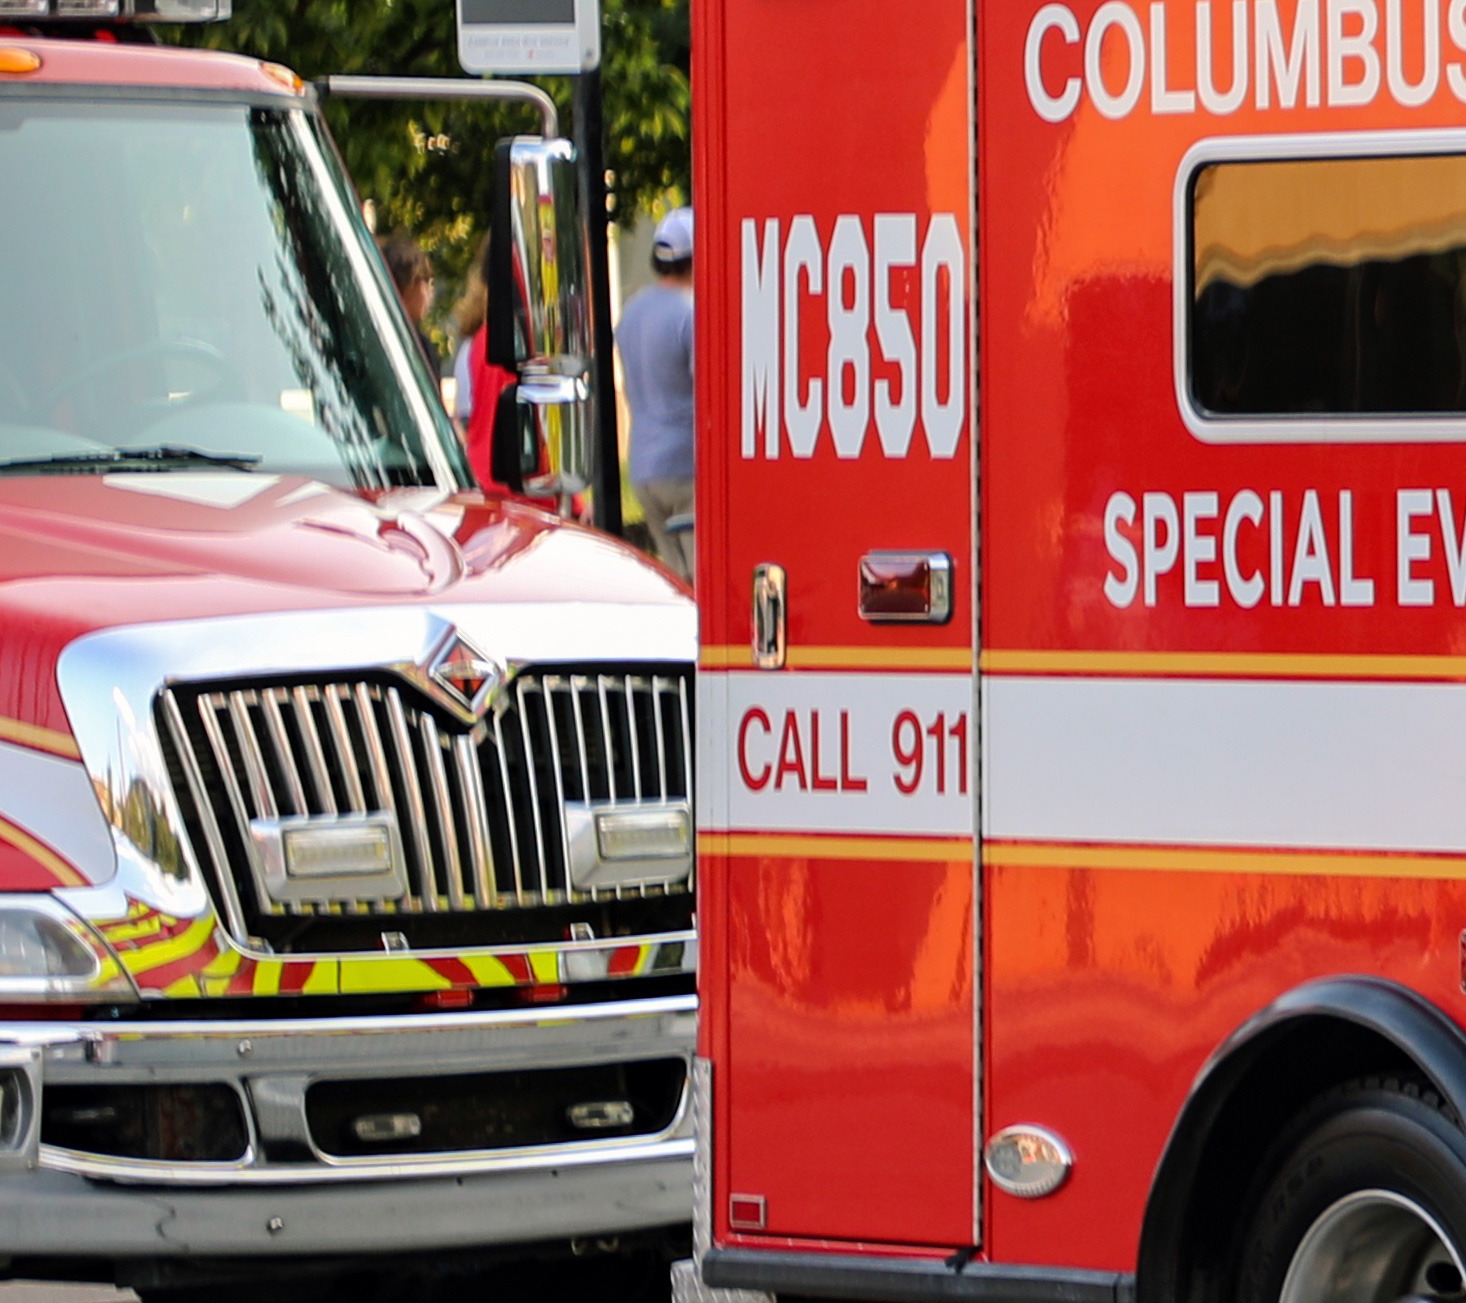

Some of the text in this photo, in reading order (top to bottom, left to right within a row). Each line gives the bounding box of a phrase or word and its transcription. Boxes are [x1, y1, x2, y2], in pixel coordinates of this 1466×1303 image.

[740, 212, 965, 460] MC850
[1103, 490, 1374, 608] SPECIAL
[737, 705, 969, 797] CALL 911
